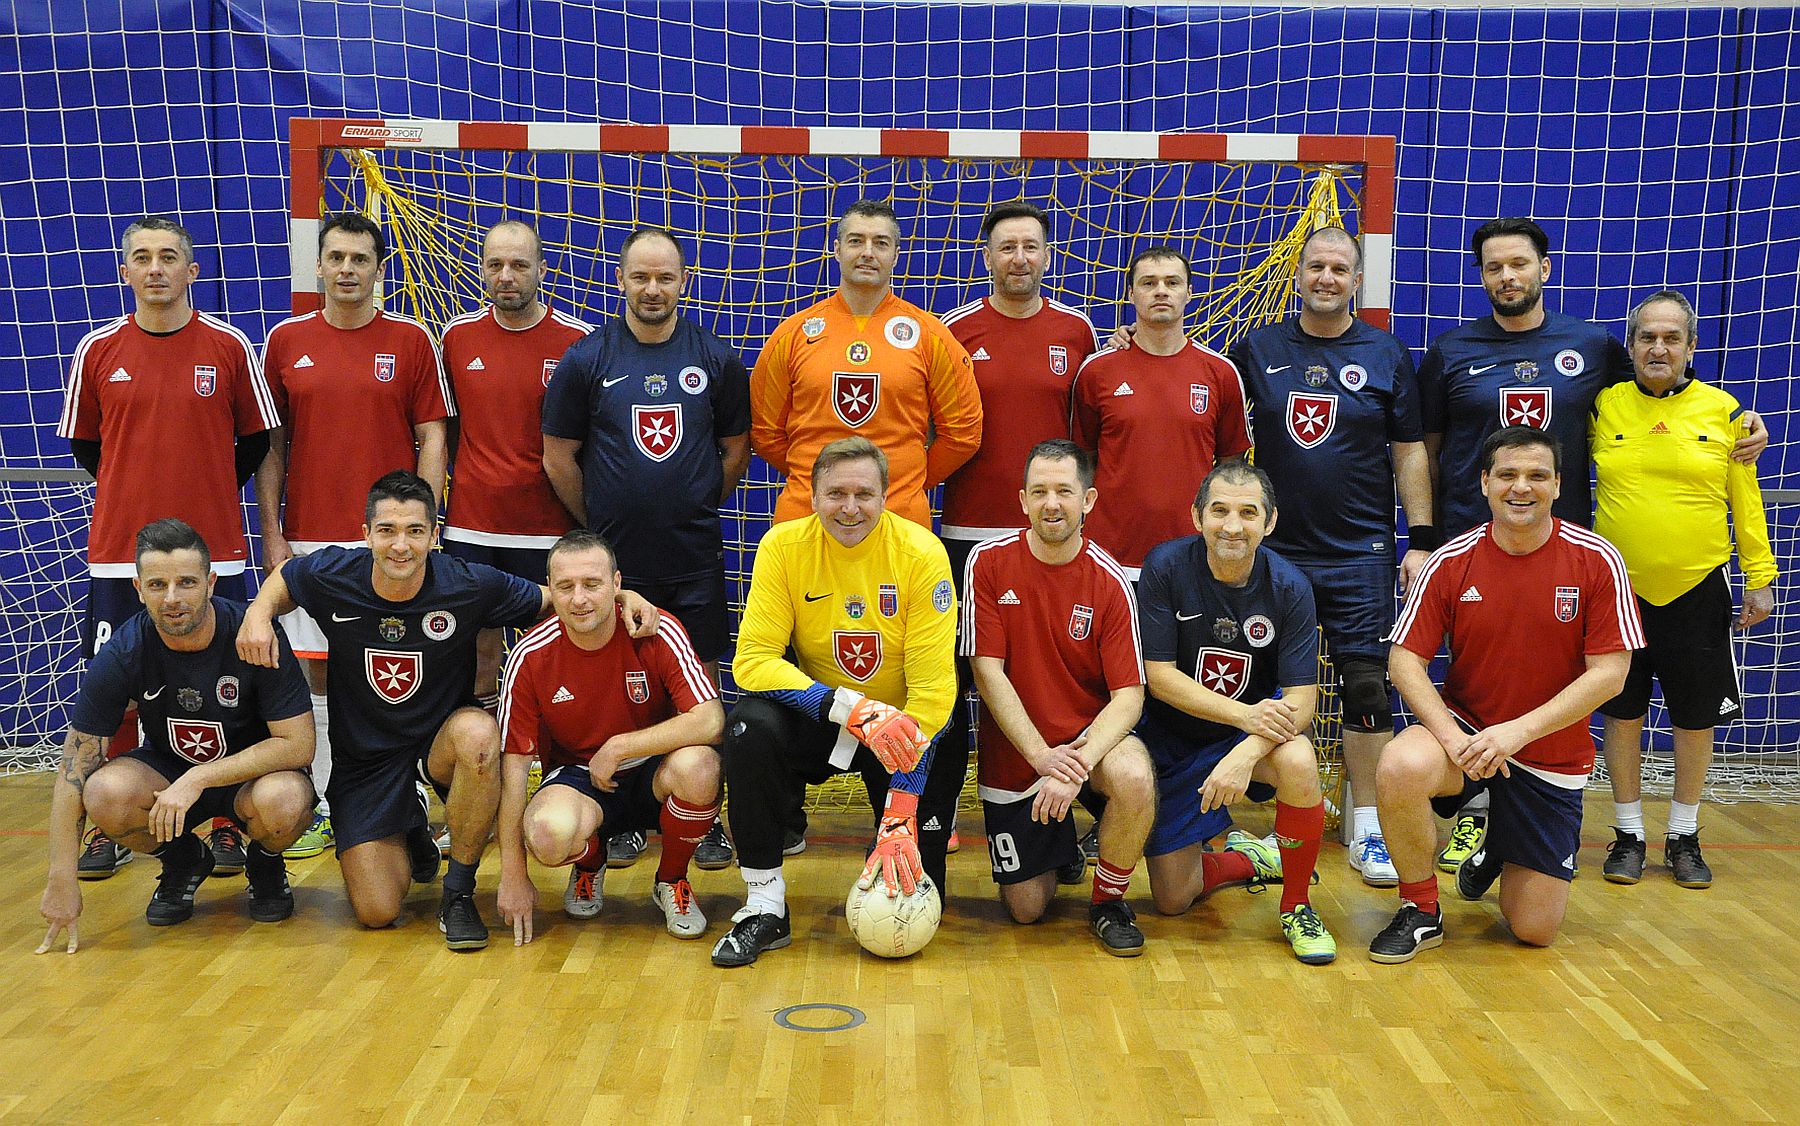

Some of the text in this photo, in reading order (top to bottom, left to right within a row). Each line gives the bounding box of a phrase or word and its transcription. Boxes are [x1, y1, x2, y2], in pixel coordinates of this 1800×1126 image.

[344, 127, 418, 138] ERHARD SPORT
[1113, 389, 1134, 397] adidas
[551, 694, 575, 704] adidas
[1719, 703, 1739, 715] adidas
[988, 832, 1021, 873] 19
